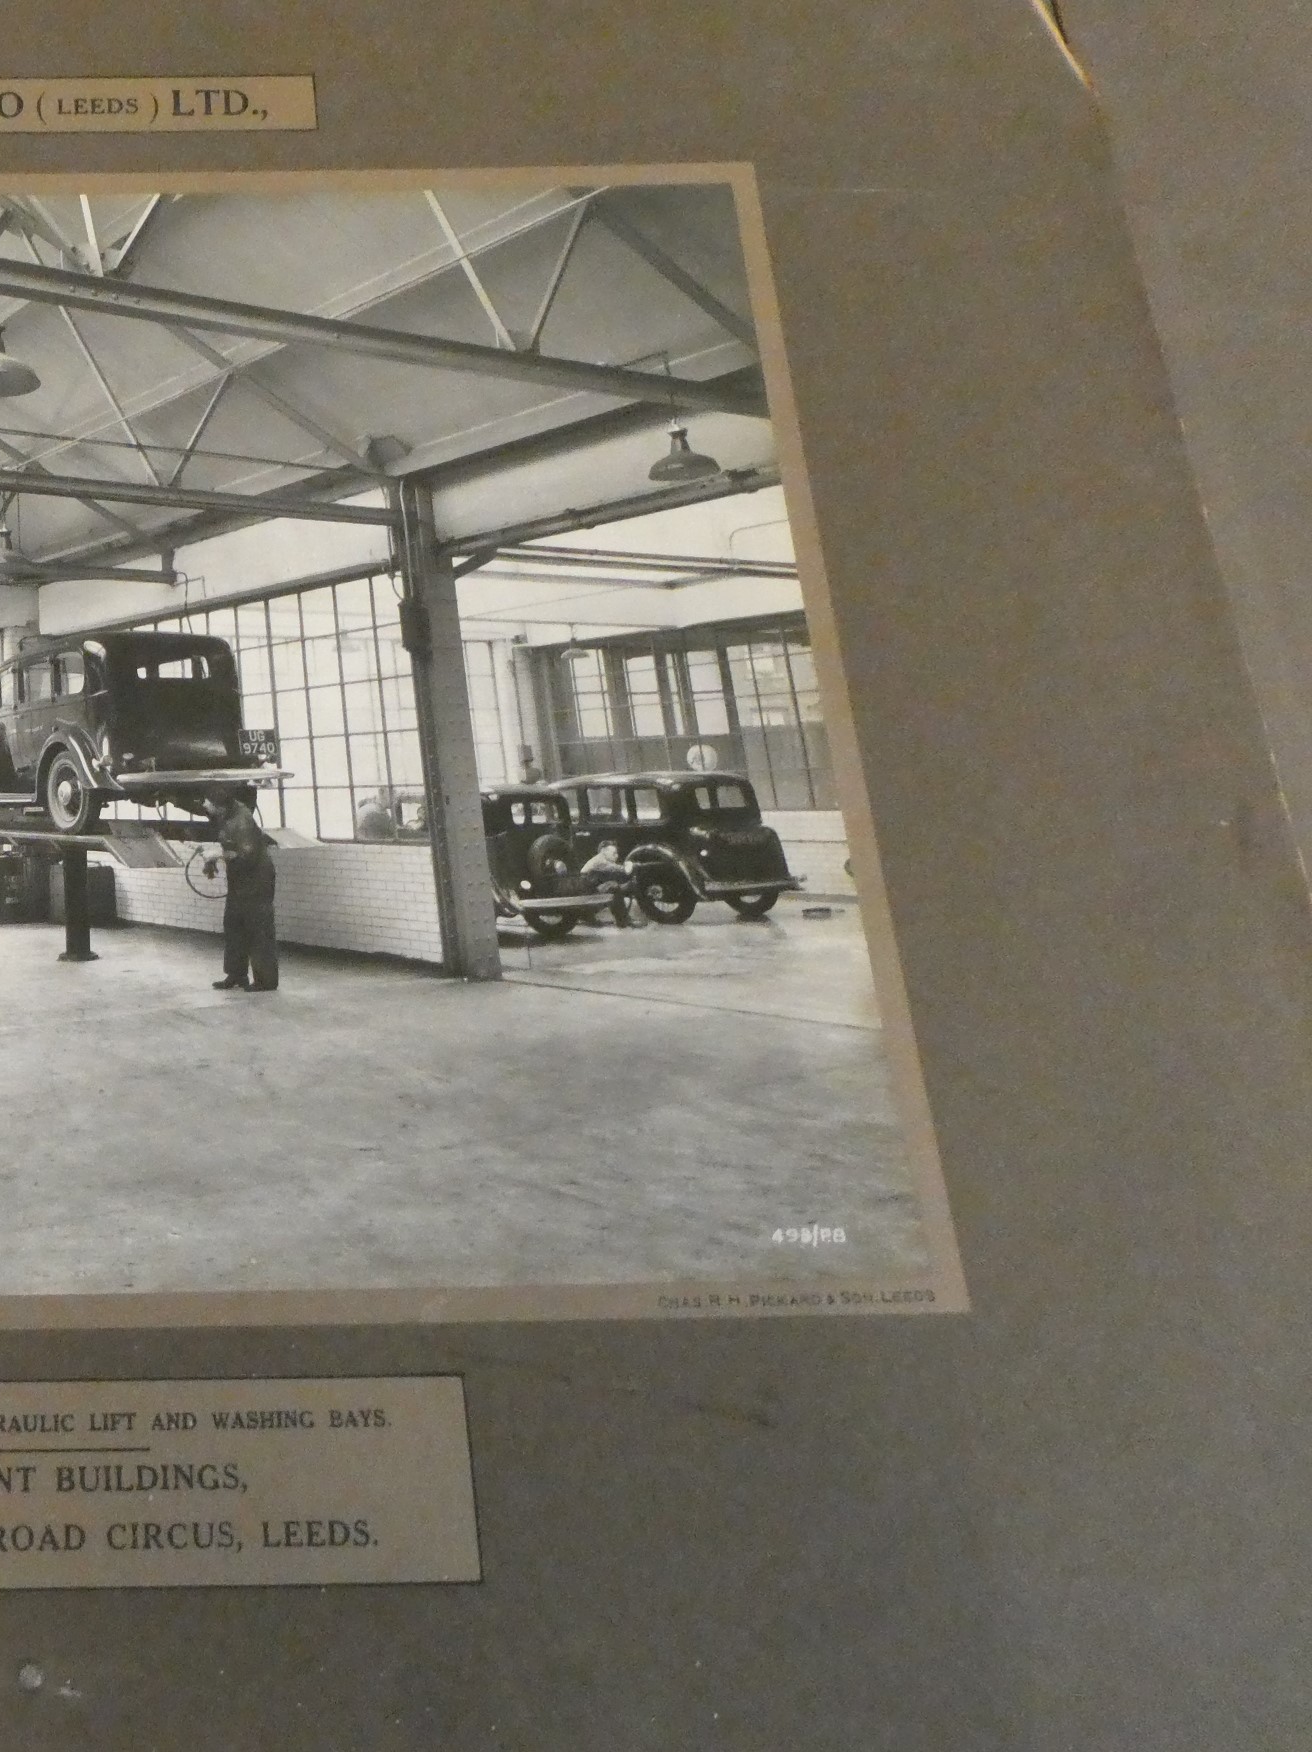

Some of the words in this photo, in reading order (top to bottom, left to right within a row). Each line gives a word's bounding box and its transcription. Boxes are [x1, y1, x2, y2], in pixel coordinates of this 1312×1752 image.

[171, 89, 269, 121] LTD.,
[249, 730, 265, 742] UG
[88, 1412, 137, 1432] LIFT
[151, 1411, 198, 1431] AND
[211, 1409, 315, 1430] WASHING
[328, 1408, 392, 1428] BAYS.
[55, 1463, 249, 1494] BUILDINGS,
[106, 1520, 243, 1553] CIRCUS,
[261, 1519, 379, 1549] LEEDS.
